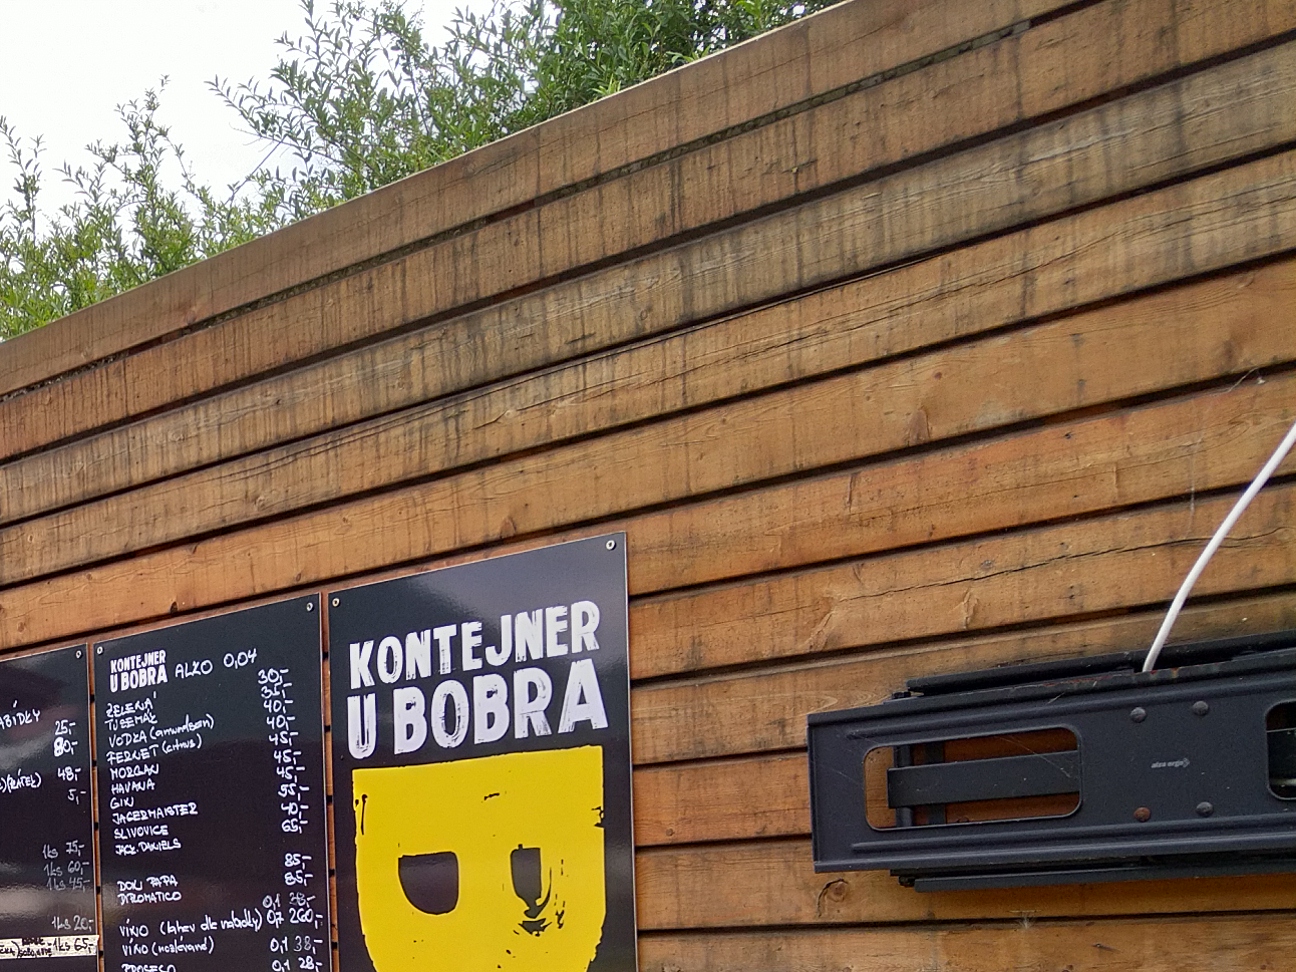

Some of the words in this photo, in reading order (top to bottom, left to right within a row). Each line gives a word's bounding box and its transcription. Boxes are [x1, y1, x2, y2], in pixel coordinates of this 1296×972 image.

[349, 600, 600, 690] KONTEJNER
[110, 649, 166, 674] KONTEJNER
[109, 673, 118, 693] U
[120, 665, 168, 691] BOBRA
[347, 690, 377, 759] U
[393, 658, 608, 755] BOBRA
[109, 796, 134, 810] GIN
[113, 825, 169, 840] SLIVOVICE
